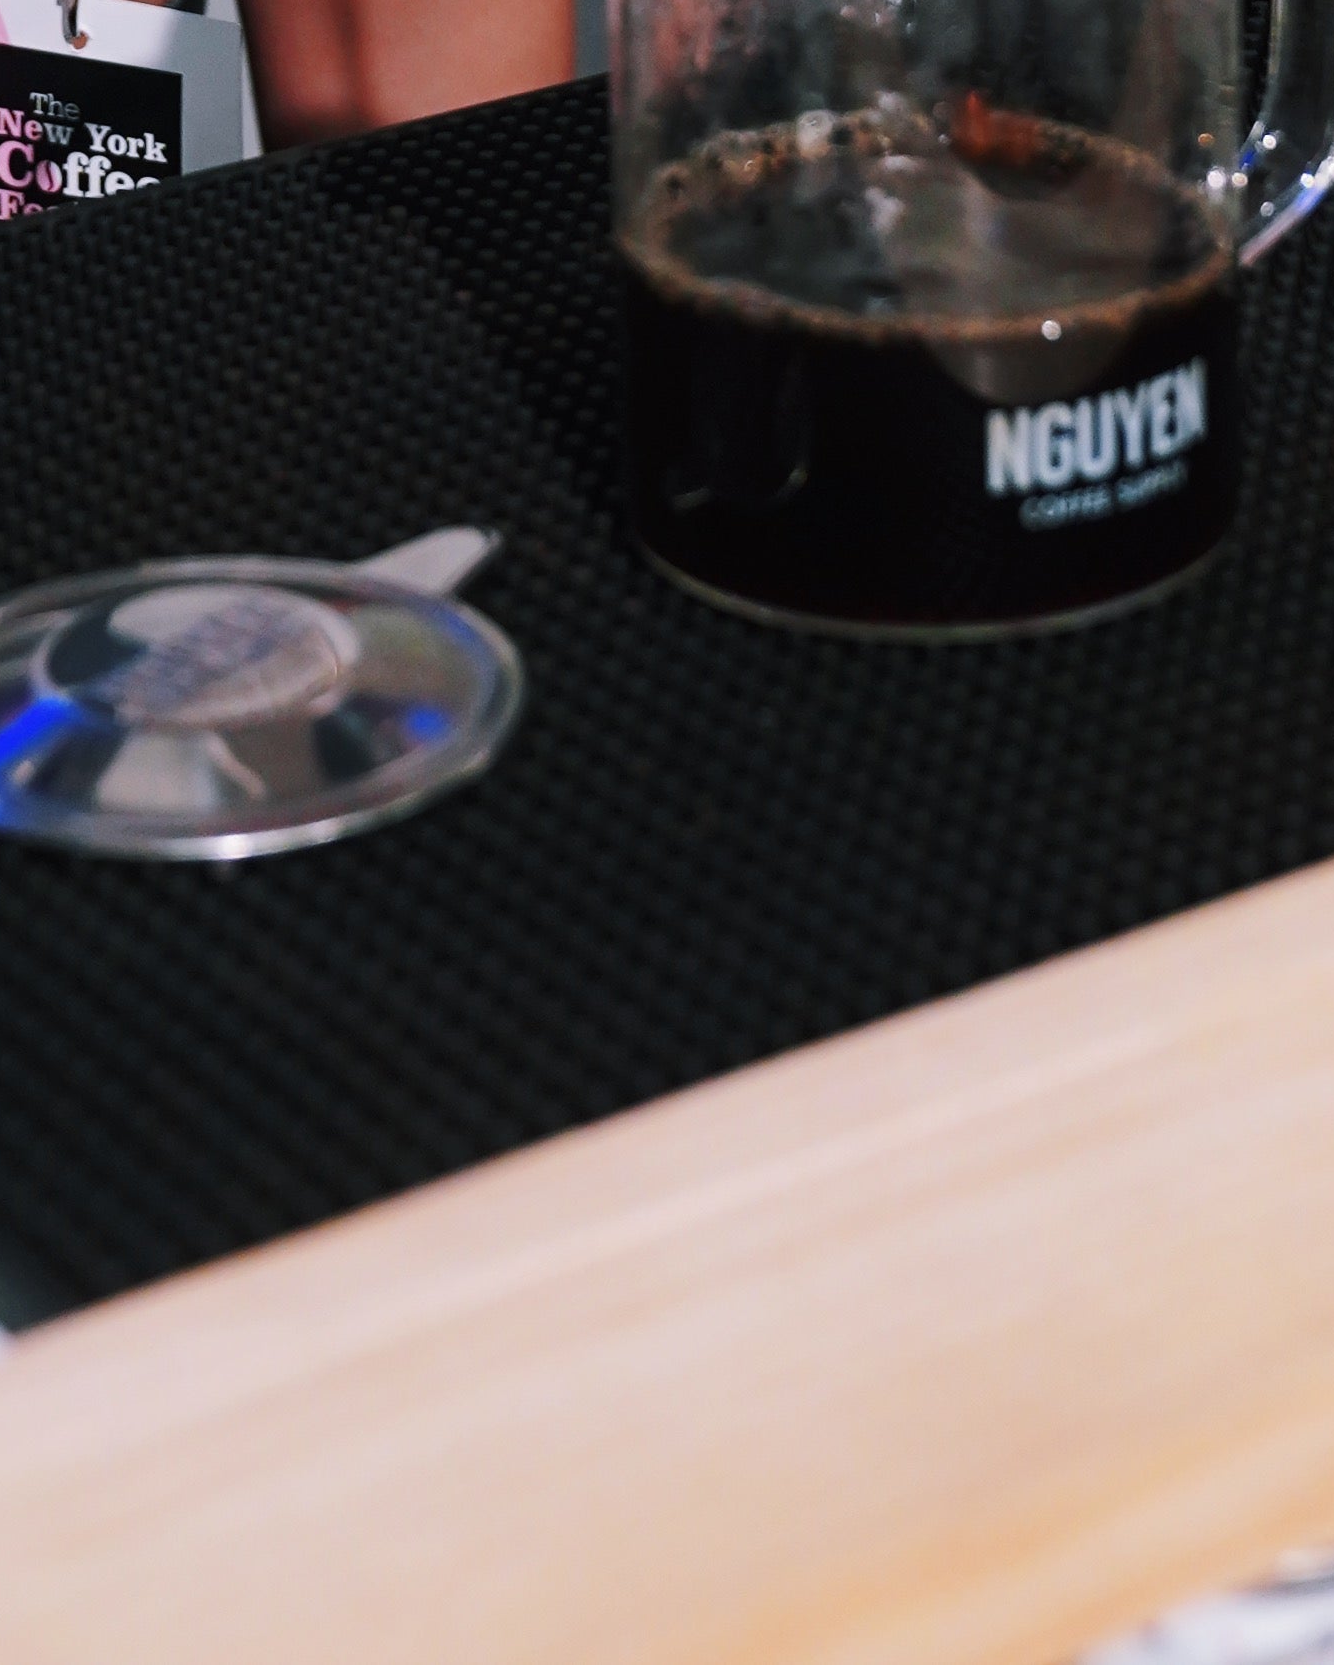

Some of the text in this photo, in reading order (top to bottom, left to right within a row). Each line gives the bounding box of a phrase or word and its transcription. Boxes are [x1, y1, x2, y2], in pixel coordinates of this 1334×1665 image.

[30, 91, 80, 120] The
[84, 123, 167, 164] York
[986, 358, 1206, 495] NGUYEN
